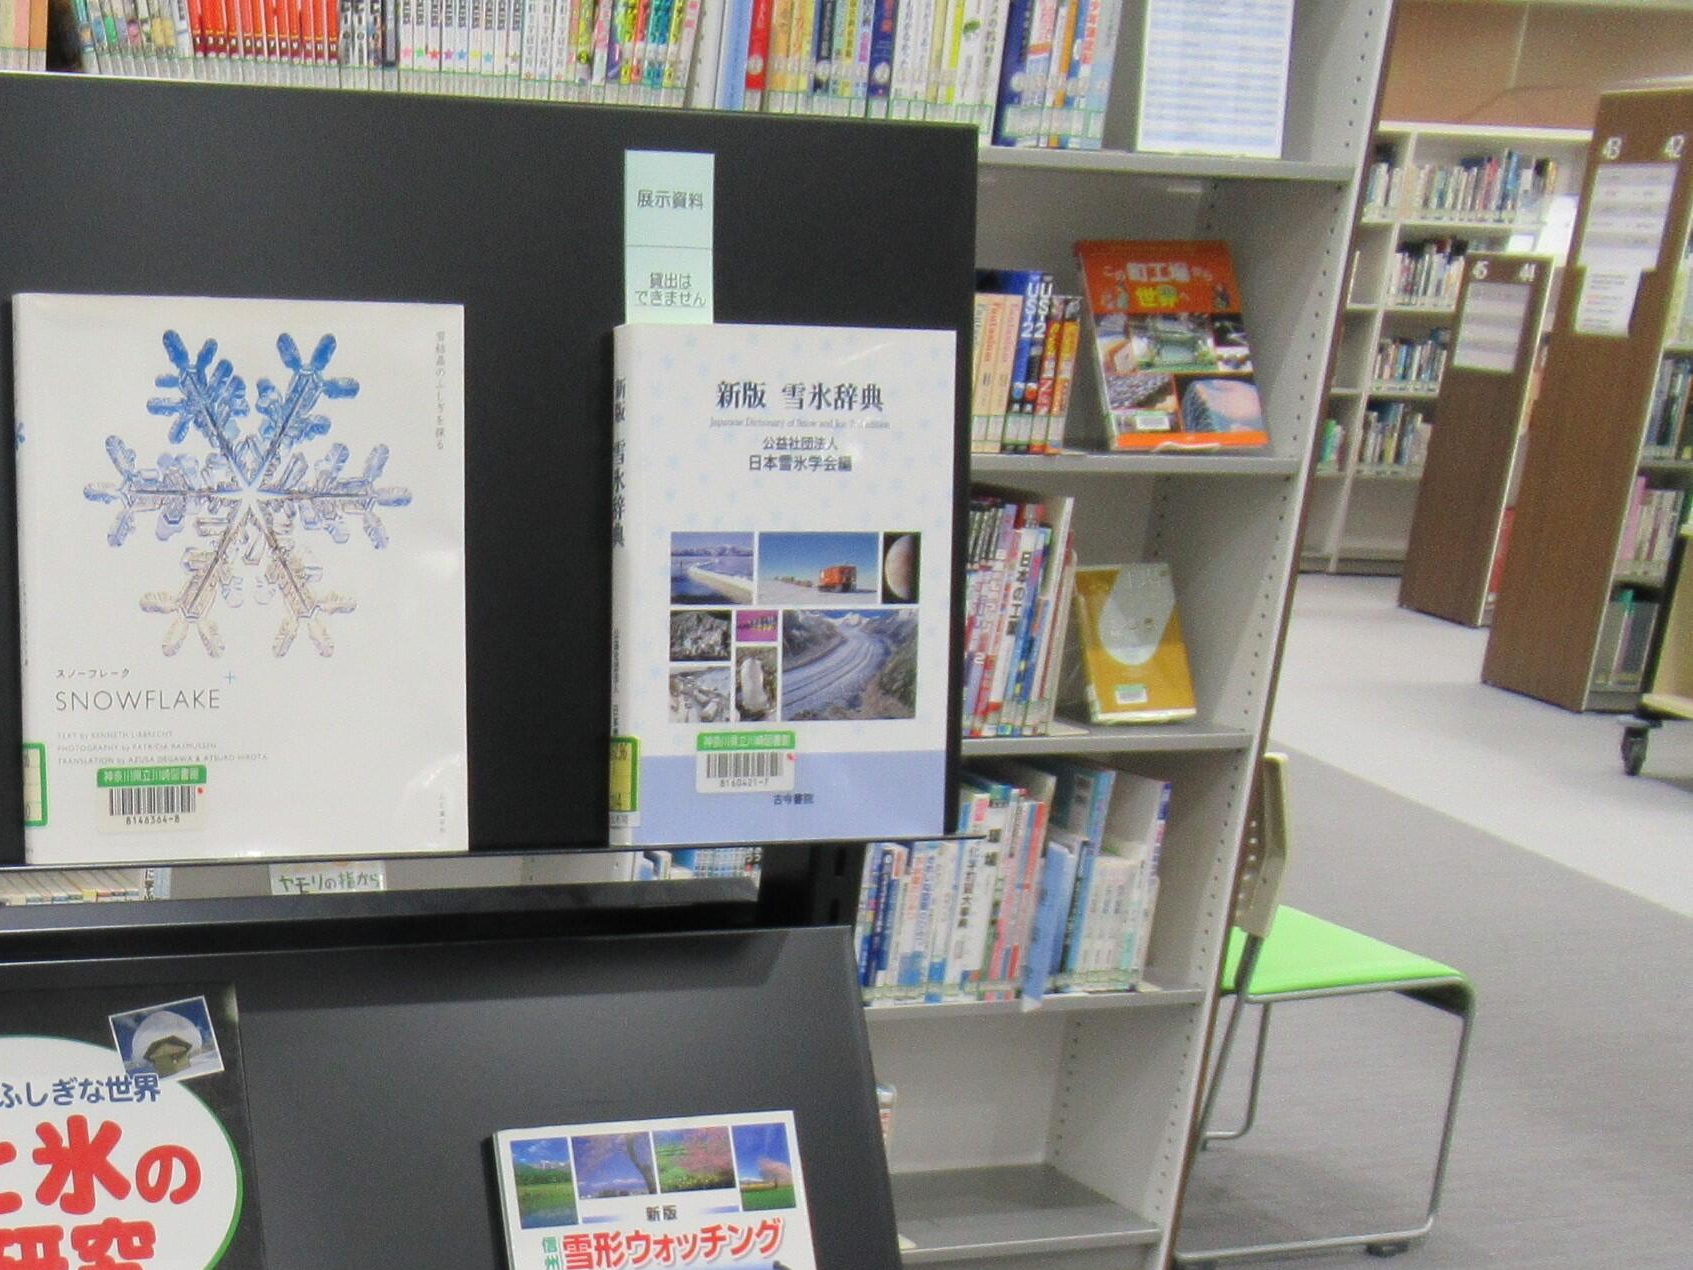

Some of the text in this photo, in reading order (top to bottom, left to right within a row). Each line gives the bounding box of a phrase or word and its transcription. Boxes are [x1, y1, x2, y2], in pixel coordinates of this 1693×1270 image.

[637, 189, 704, 210] 展示資料
[649, 273, 691, 289] 貸出は
[635, 290, 706, 307] できません
[717, 380, 884, 412] 新版 雪氷辞典
[763, 436, 839, 451] 公益社団法人
[749, 455, 852, 472] 日本雪氷学会編
[56, 668, 129, 680] スノーフレーク
[55, 689, 221, 712] SNOWFLAKE
[126, 814, 180, 825] 8146364-8
[646, 1206, 678, 1222] 新版
[562, 1217, 783, 1270] 雪形ウォッチング
